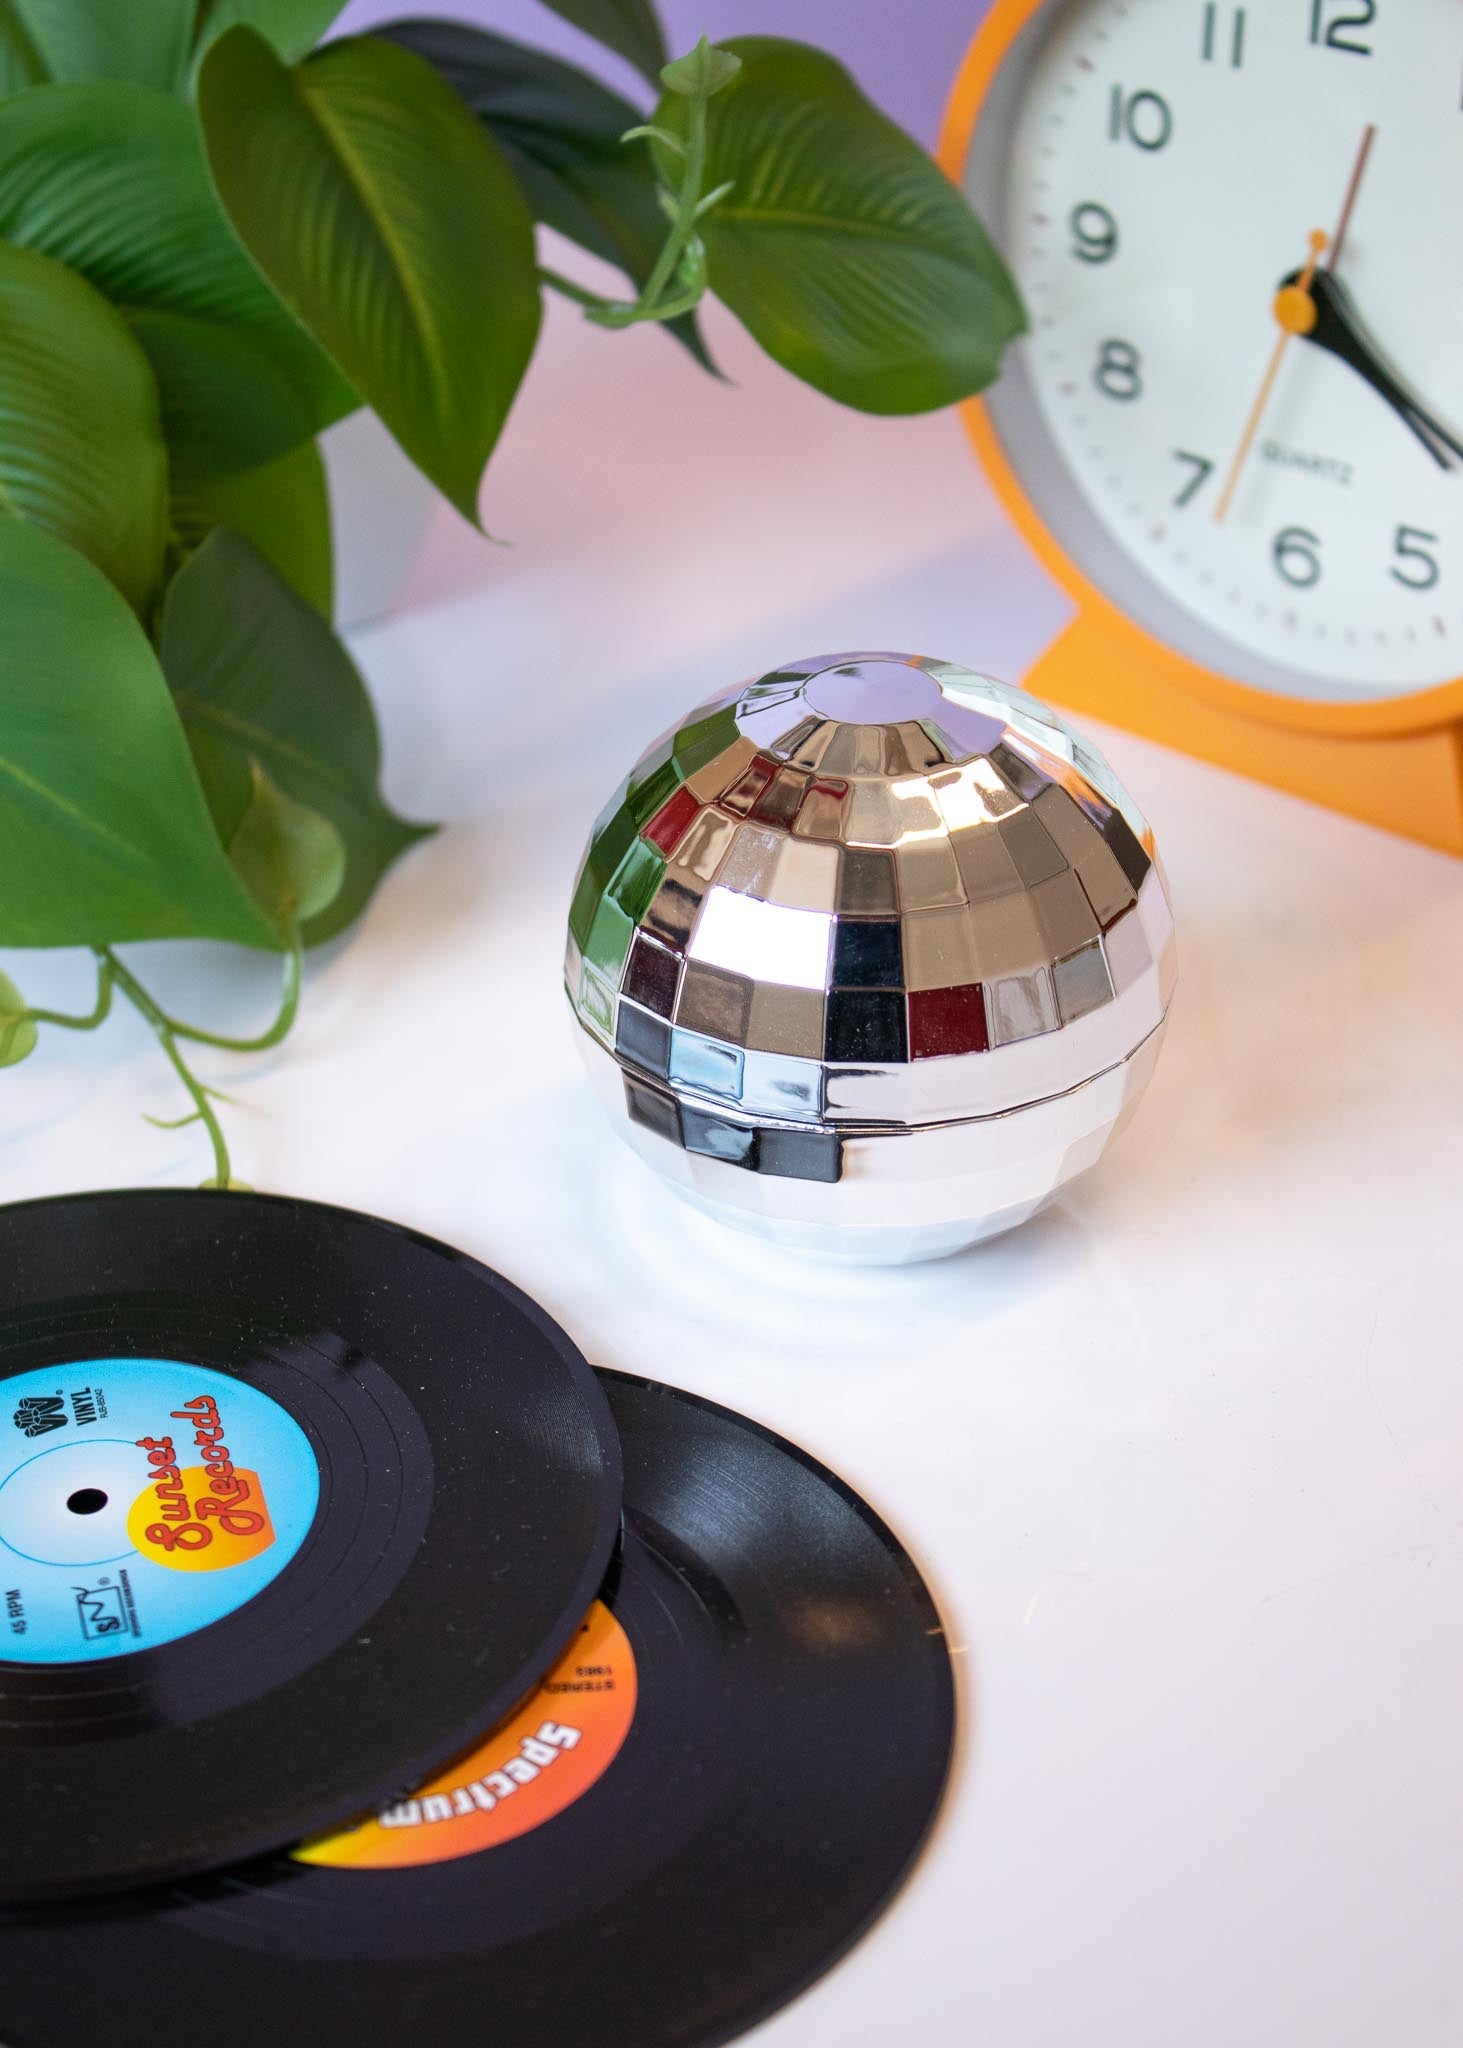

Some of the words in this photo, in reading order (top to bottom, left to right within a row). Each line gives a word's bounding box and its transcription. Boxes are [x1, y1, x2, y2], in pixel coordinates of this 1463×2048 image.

[1309, 0, 1377, 55] 12
[1109, 85, 1172, 152] 10
[1071, 202, 1118, 265] 9
[1094, 338, 1142, 402] 8
[1172, 449, 1214, 508] 7
[1259, 438, 1355, 486] QUARTZ
[1272, 526, 1321, 589] 6
[1390, 525, 1440, 591] 5
[70, 1387, 98, 1426] VINYL
[135, 1436, 213, 1552] Sunset
[170, 1394, 265, 1536] Records
[5, 1588, 24, 1618] RPM
